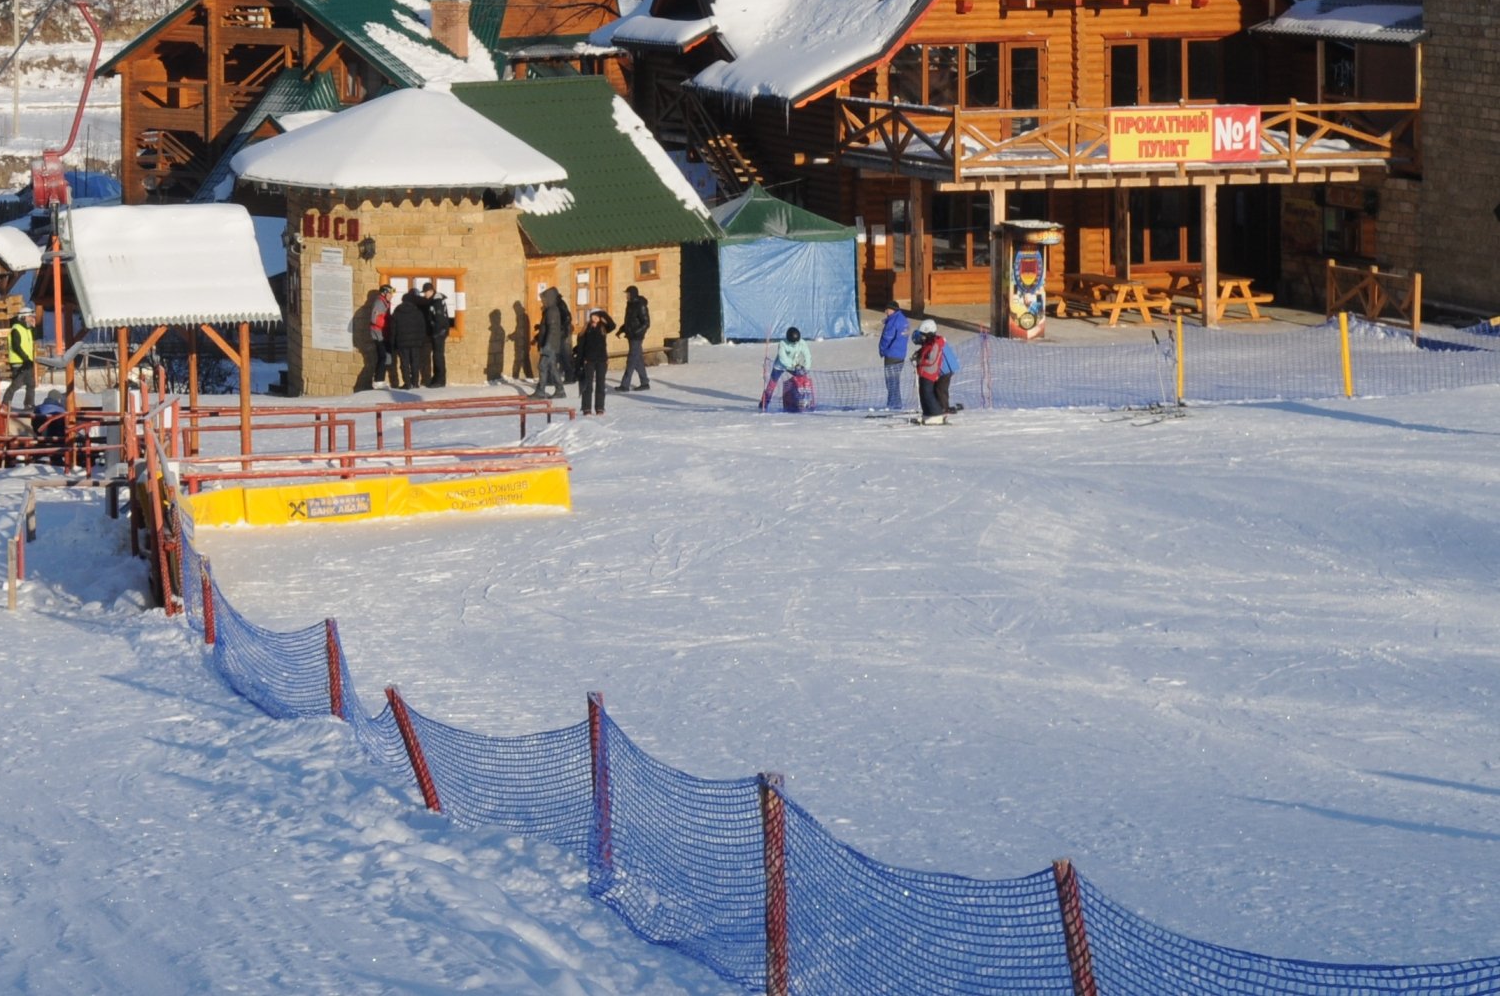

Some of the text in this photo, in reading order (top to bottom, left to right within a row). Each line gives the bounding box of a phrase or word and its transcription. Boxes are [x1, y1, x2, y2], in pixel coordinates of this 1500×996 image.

[1114, 111, 1209, 134] ПРОКАТНИЙ
[1138, 139, 1190, 158] ПУНКТ
[303, 213, 359, 242] КАСА
